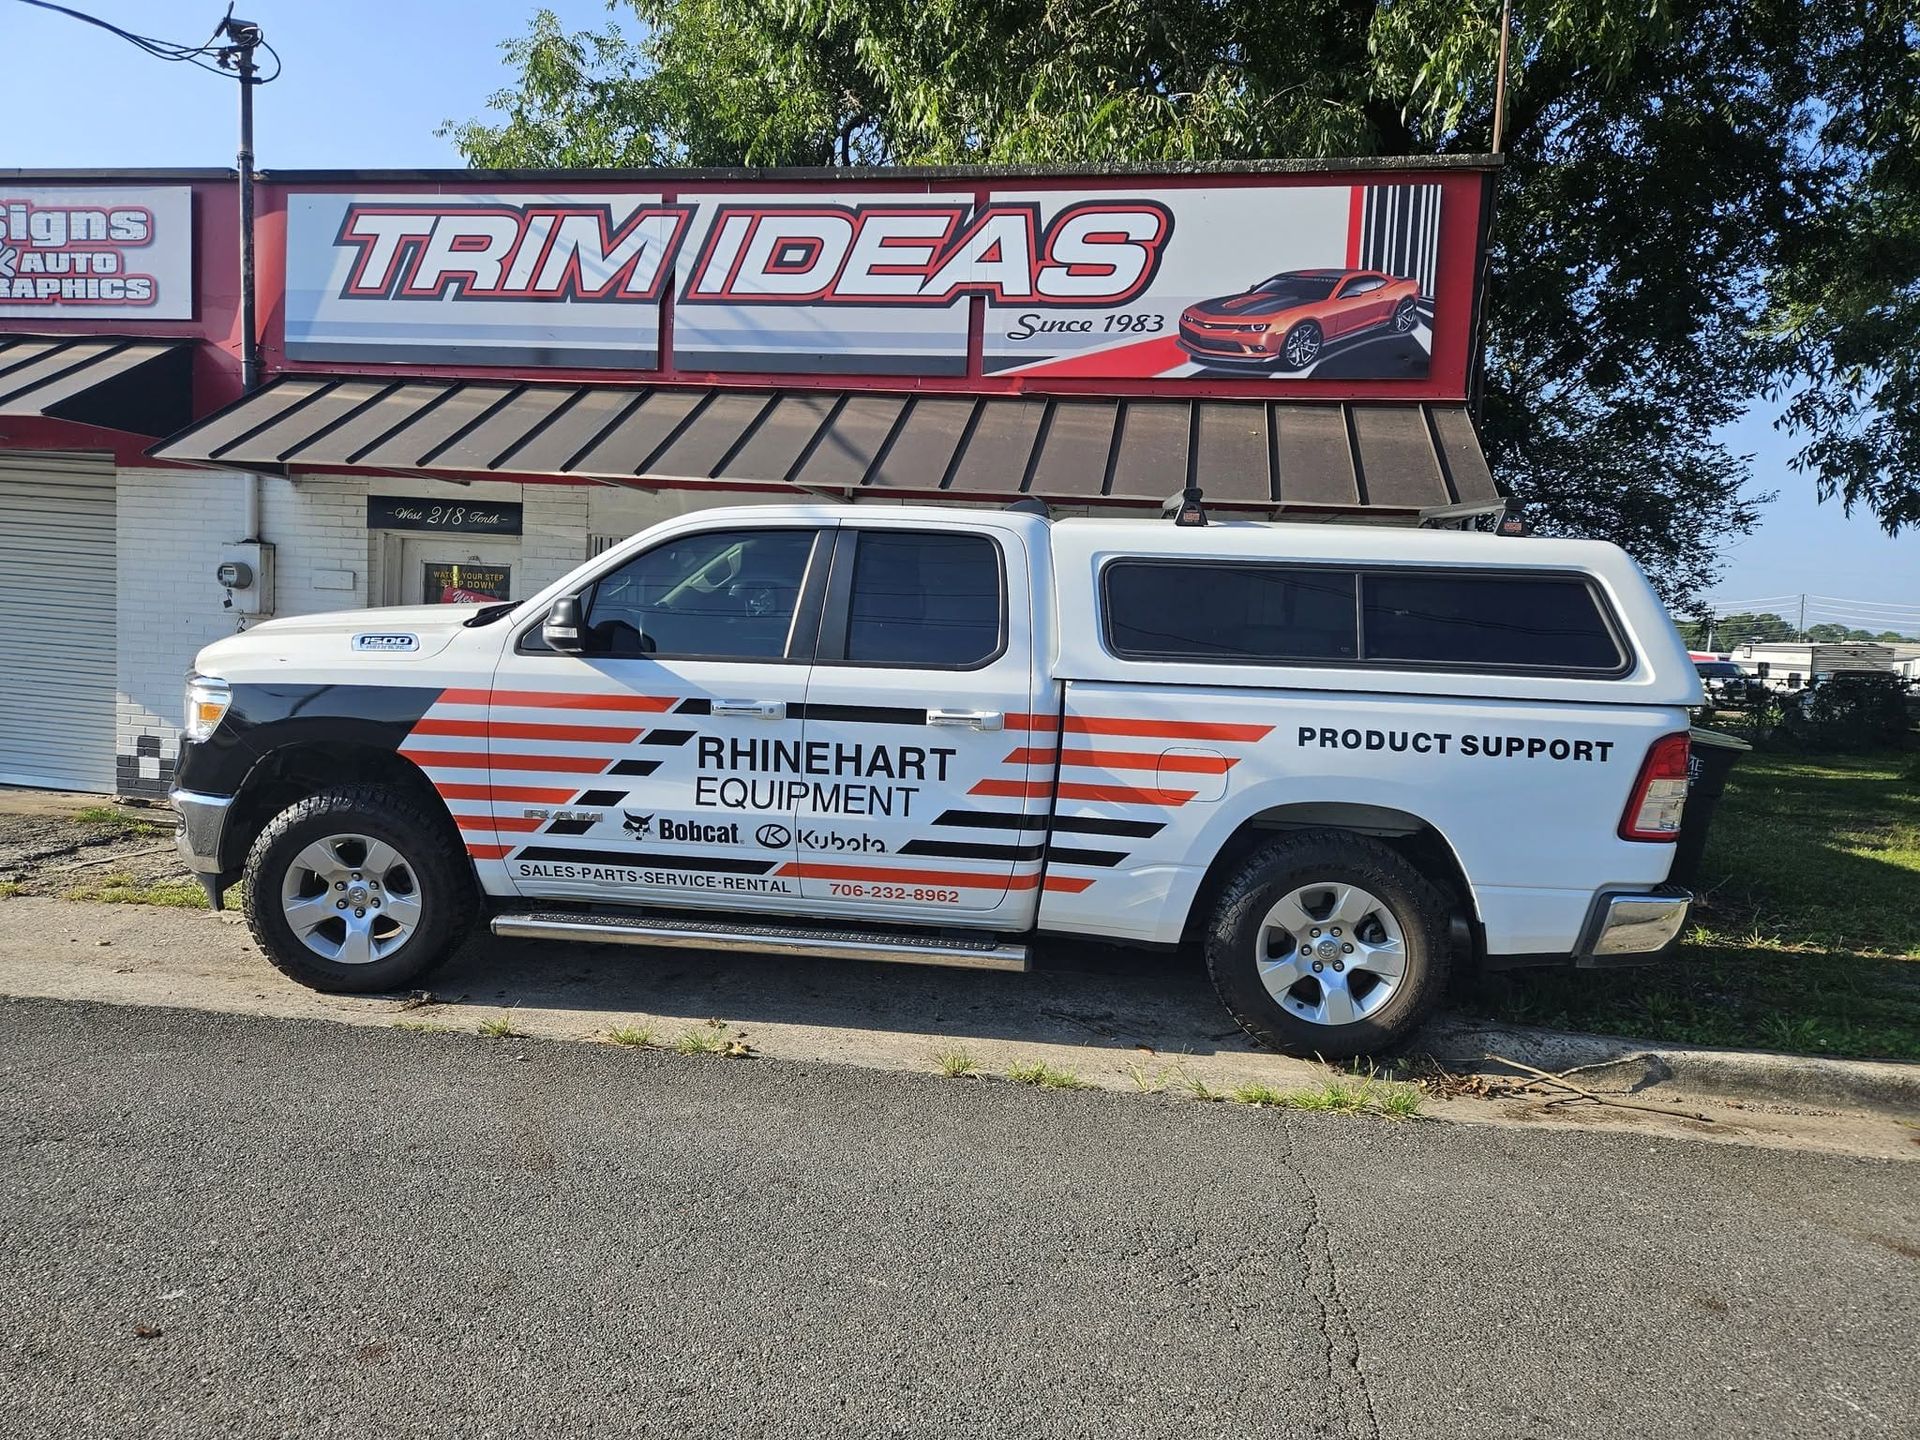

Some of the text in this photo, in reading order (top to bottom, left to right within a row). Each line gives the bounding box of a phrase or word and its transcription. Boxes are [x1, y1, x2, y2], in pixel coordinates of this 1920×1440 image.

[0, 202, 151, 249] igns
[19, 251, 119, 275] AUTO
[336, 200, 1175, 307] TRIM IDEAS
[1006, 313, 1165, 340] Since 1983
[426, 506, 466, 525] 218
[433, 570, 505, 582] WATC YOUR STEP
[440, 578, 495, 590] STP DOWN
[363, 636, 410, 645] 1500
[1298, 726, 1615, 762] PRODUCT SUPPORT
[698, 736, 957, 781] RHINEHART
[695, 776, 920, 817] EQUIPMENT
[523, 808, 604, 823] RAM
[659, 818, 740, 844] Bobcat
[797, 829, 886, 853] Kubota
[829, 883, 960, 903] 706-232-8962
